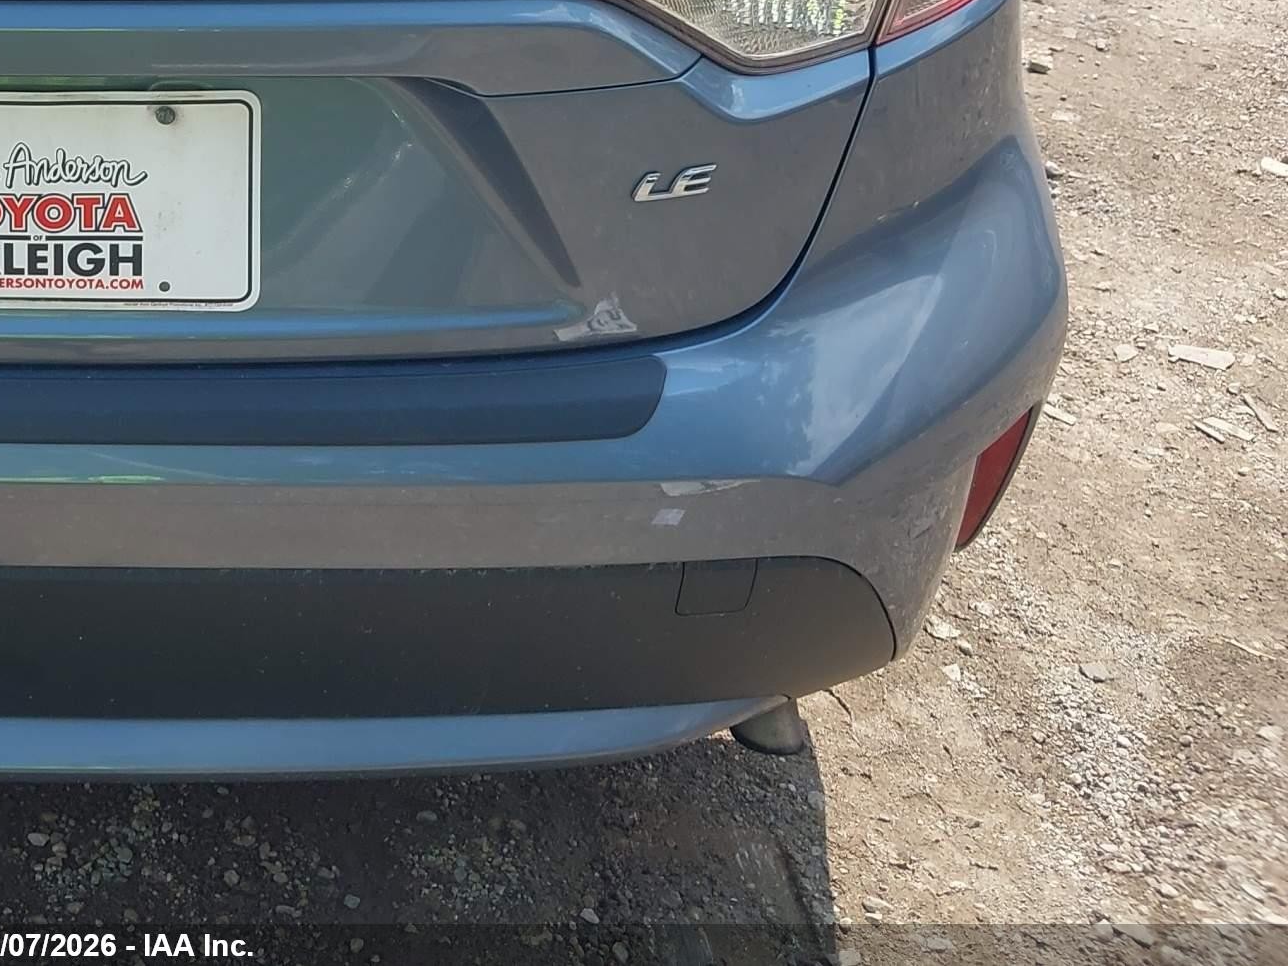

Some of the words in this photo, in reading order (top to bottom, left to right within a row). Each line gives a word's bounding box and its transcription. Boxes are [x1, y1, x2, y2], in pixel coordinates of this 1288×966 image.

[3, 142, 148, 188] Anderson
[631, 163, 717, 202] LE
[33, 234, 44, 242] OF
